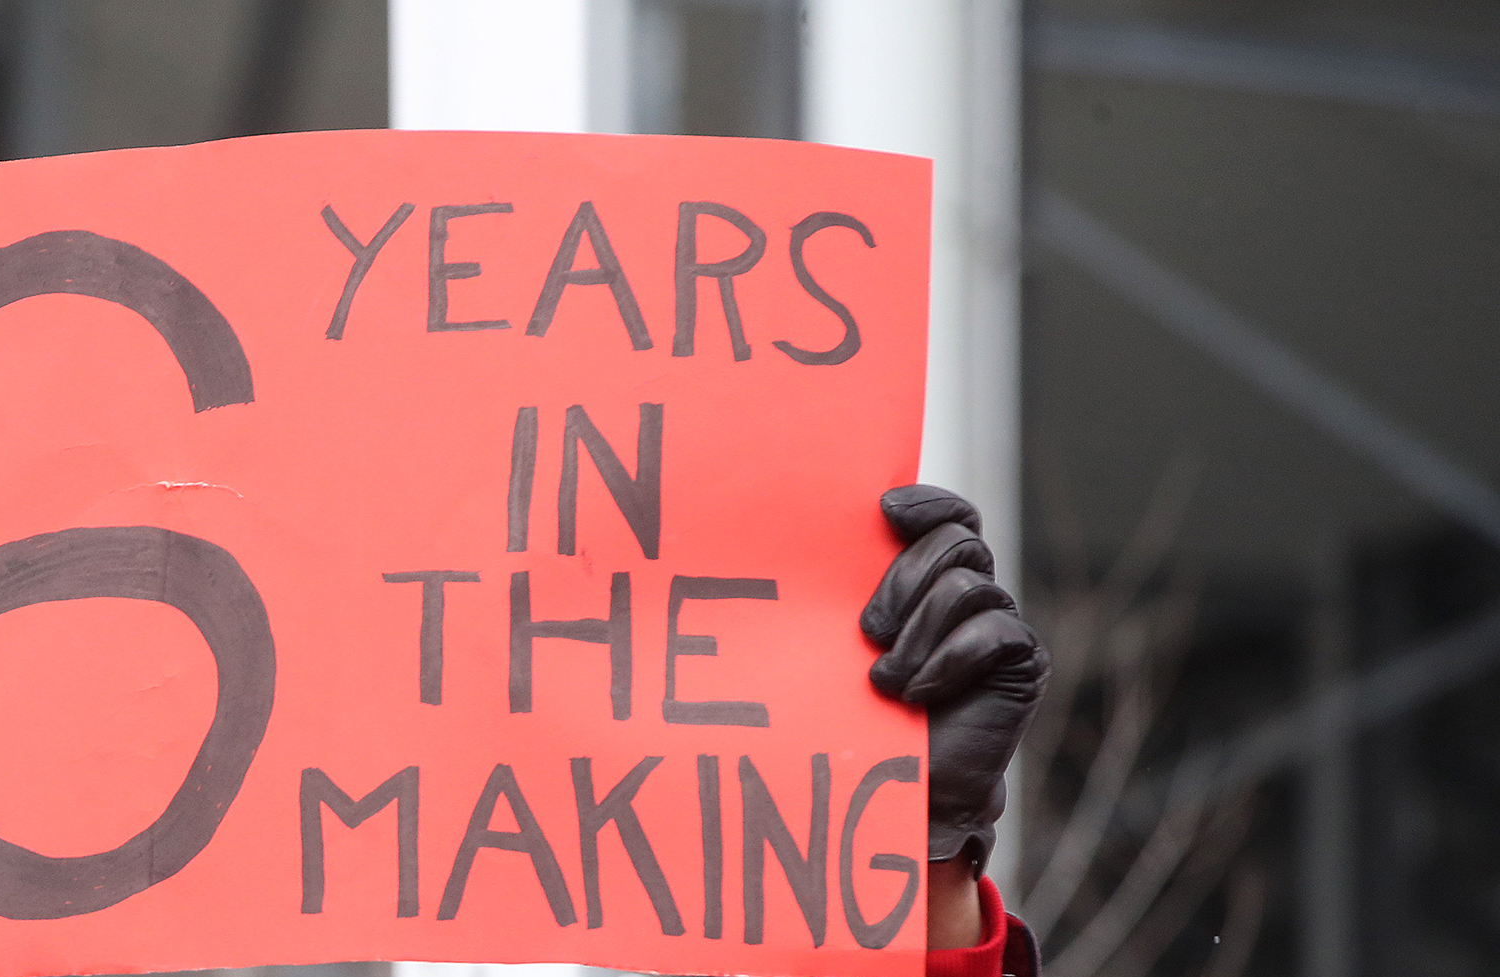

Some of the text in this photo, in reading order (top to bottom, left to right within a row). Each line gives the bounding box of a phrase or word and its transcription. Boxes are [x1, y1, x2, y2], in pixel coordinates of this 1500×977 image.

[319, 201, 877, 366] YEARS
[506, 403, 664, 560] IN
[382, 570, 779, 728] THE
[300, 753, 921, 950] MAKING
